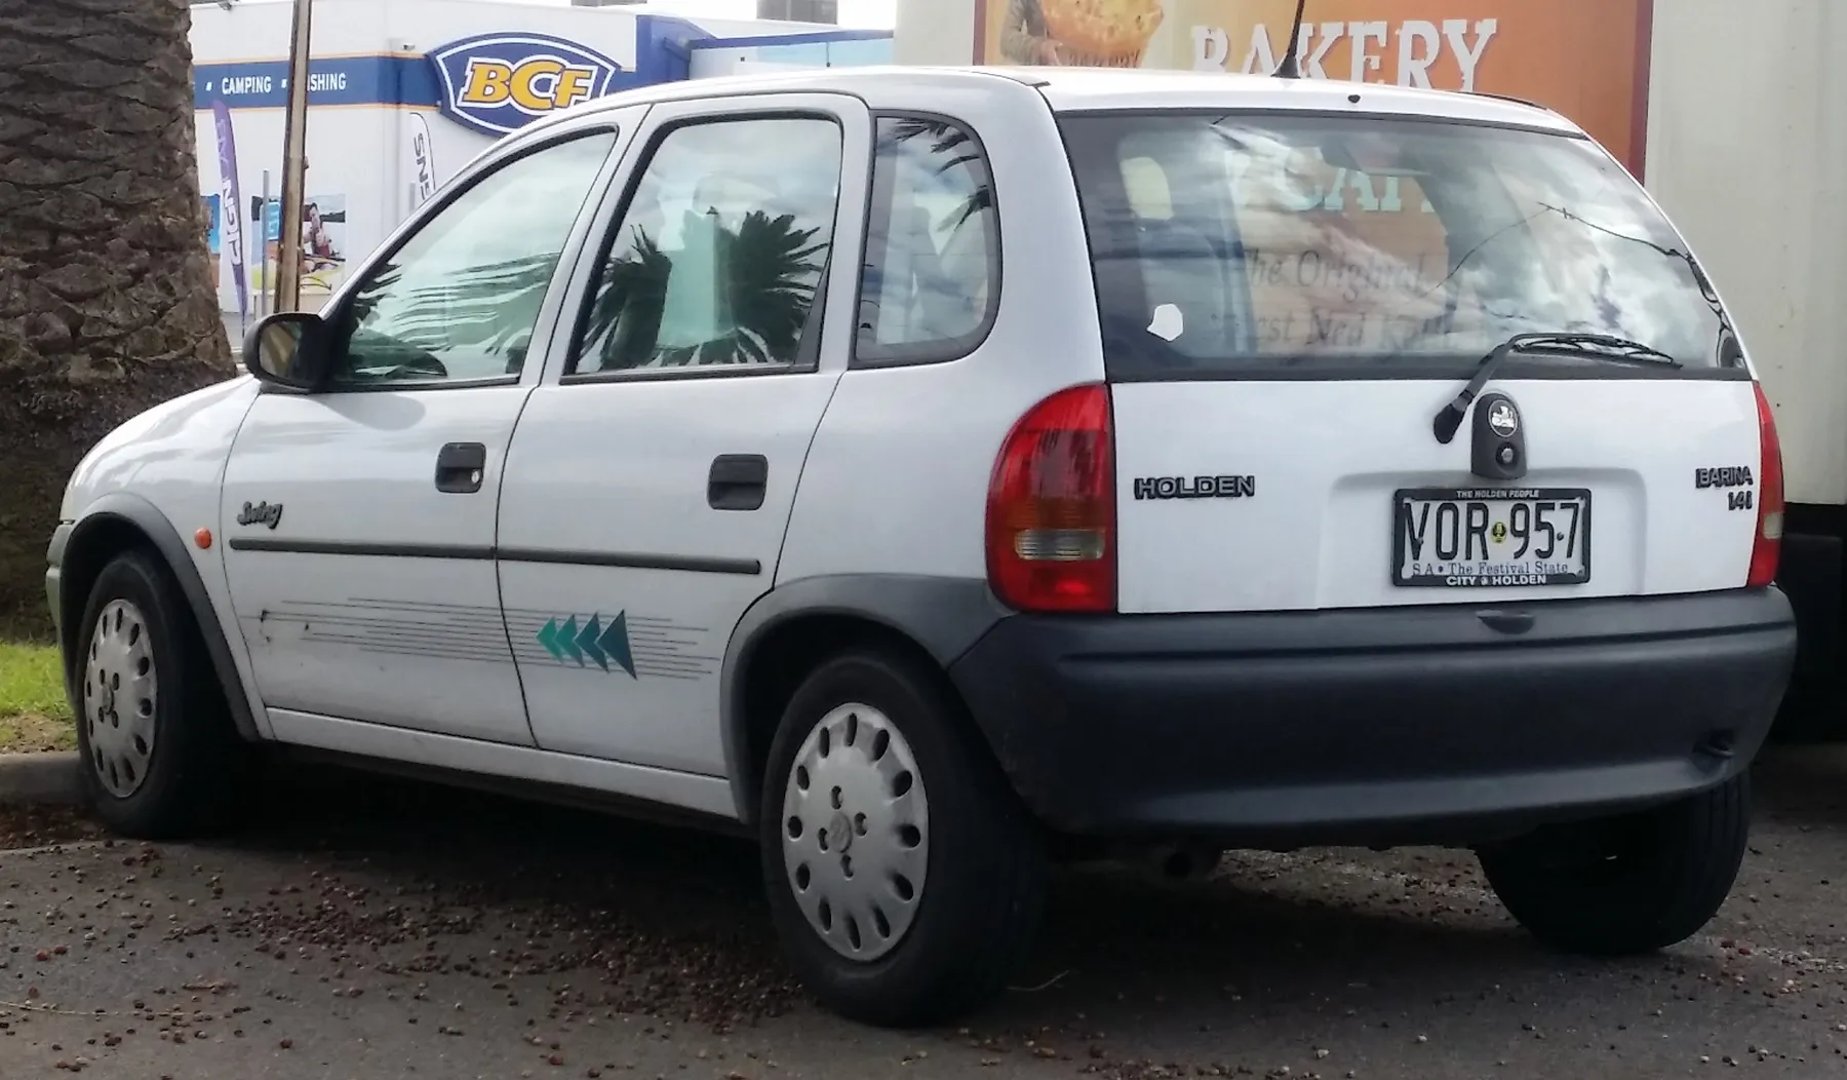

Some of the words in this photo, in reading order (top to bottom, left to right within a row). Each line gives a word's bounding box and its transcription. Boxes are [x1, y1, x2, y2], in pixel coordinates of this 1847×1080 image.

[1190, 18, 1498, 92] BAKERY
[221, 76, 272, 94] CAMPING
[306, 73, 347, 92] ISHING
[461, 59, 593, 111] BCF
[1134, 475, 1255, 500] HOLDEN
[1695, 465, 1754, 488] BARINA
[1456, 489, 1474, 499] THE
[1475, 489, 1508, 498] HOLDEN
[1509, 488, 1540, 498] PEOPLE
[1403, 503, 1489, 561] VOR
[1510, 502, 1580, 560] 957
[1449, 562, 1472, 574] The
[1478, 561, 1530, 575] Festival
[1534, 560, 1569, 574] State
[1446, 576, 1476, 586] CITY
[1492, 574, 1547, 585] HOLDEN
